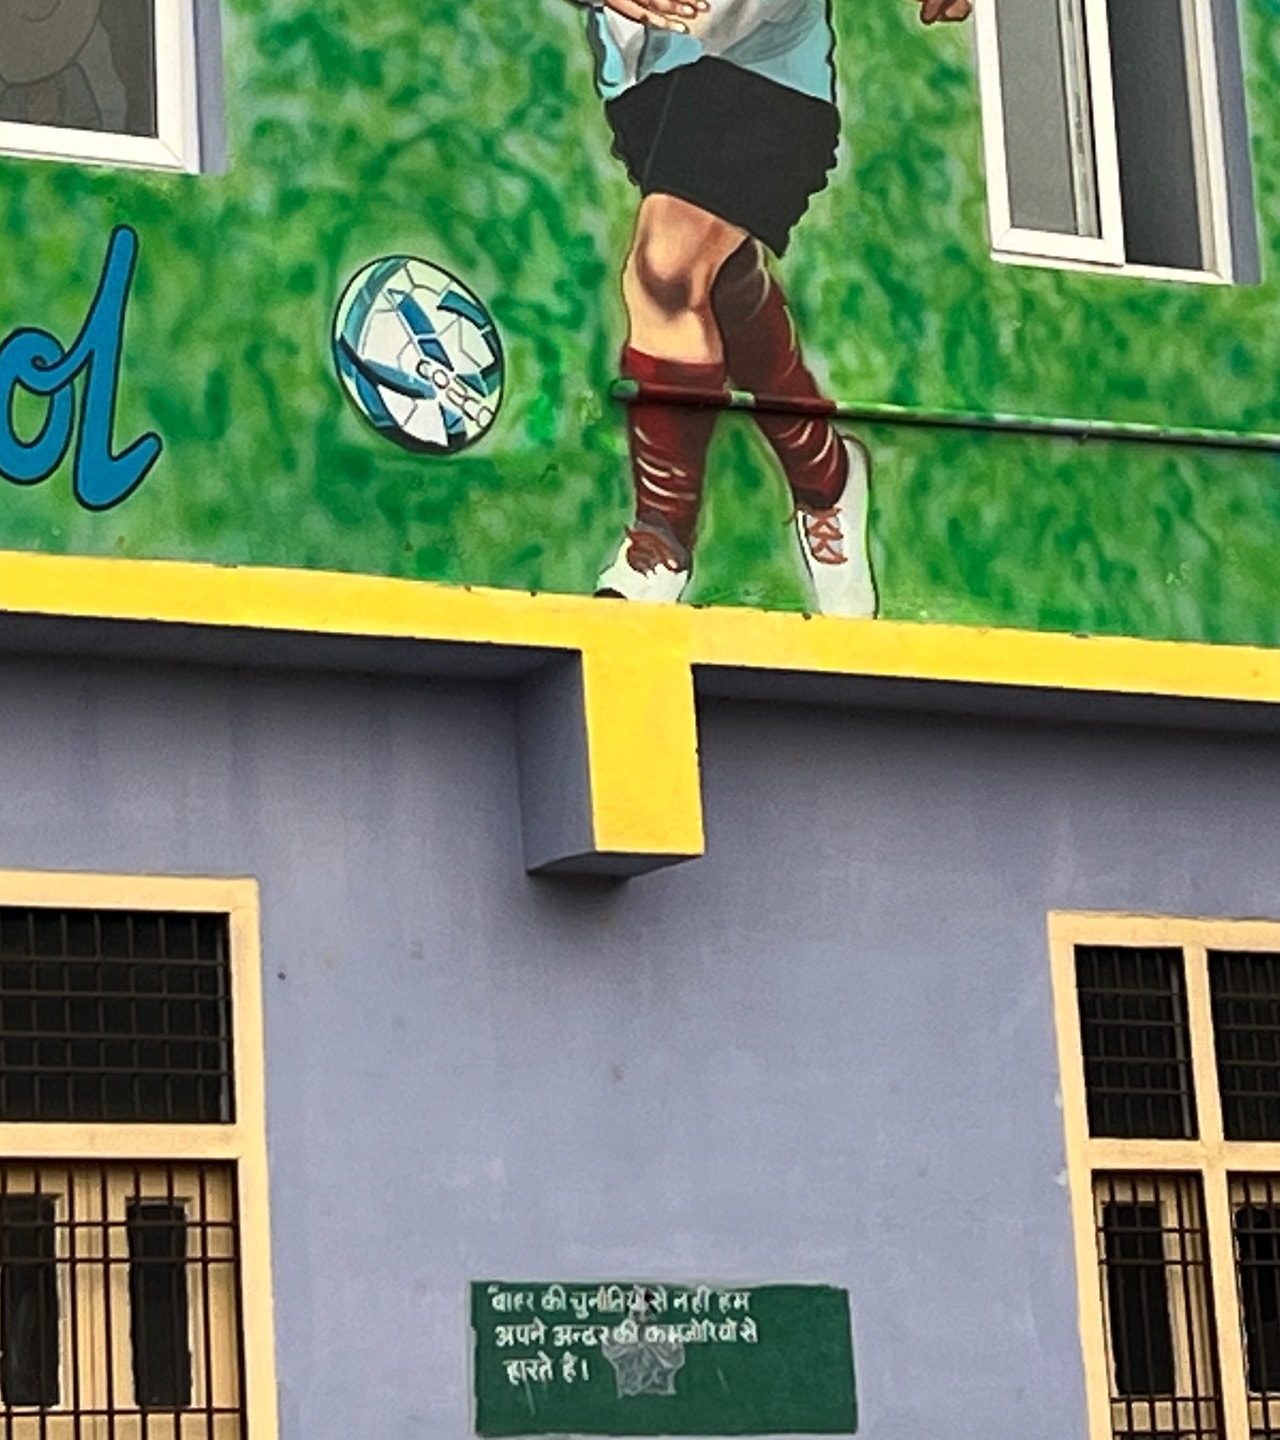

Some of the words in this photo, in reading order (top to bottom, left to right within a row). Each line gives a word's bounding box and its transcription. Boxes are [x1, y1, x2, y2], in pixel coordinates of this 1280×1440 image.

[541, 1284, 567, 1311] की
[717, 1292, 751, 1314] हम
[495, 1317, 547, 1347] अपने
[612, 1319, 638, 1344] की
[739, 1315, 759, 1344] से
[502, 1350, 554, 1386] हारते
